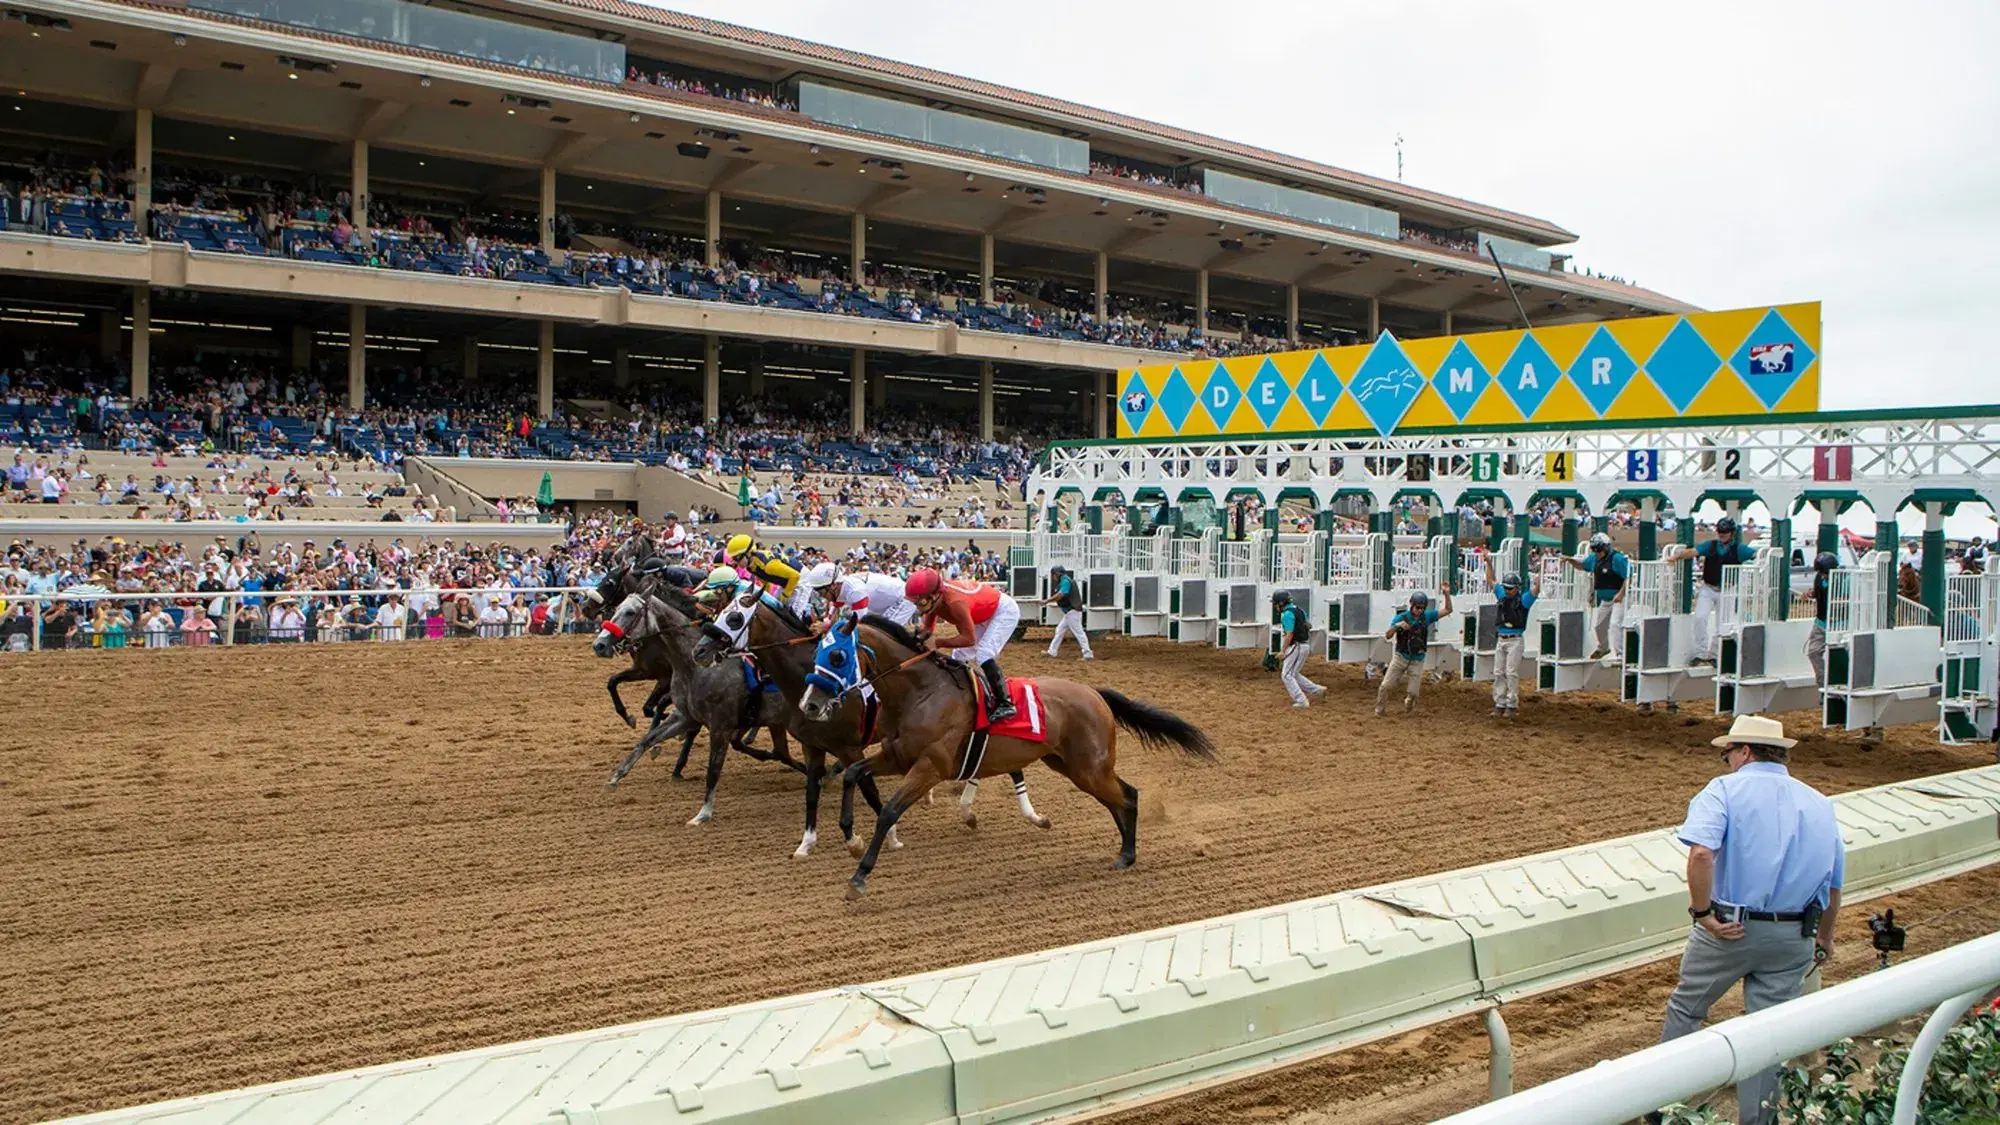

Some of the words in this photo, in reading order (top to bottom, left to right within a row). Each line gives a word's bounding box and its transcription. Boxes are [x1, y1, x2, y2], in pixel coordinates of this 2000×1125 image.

[1213, 378, 1326, 408] DEL
[1450, 357, 1612, 393] MAR
[1412, 455, 1425, 480] 6
[1479, 453, 1491, 480] 5
[1553, 452, 1566, 480] 4
[1635, 450, 1650, 480] 3
[1725, 448, 1740, 480] 2
[1823, 447, 1837, 480] 1
